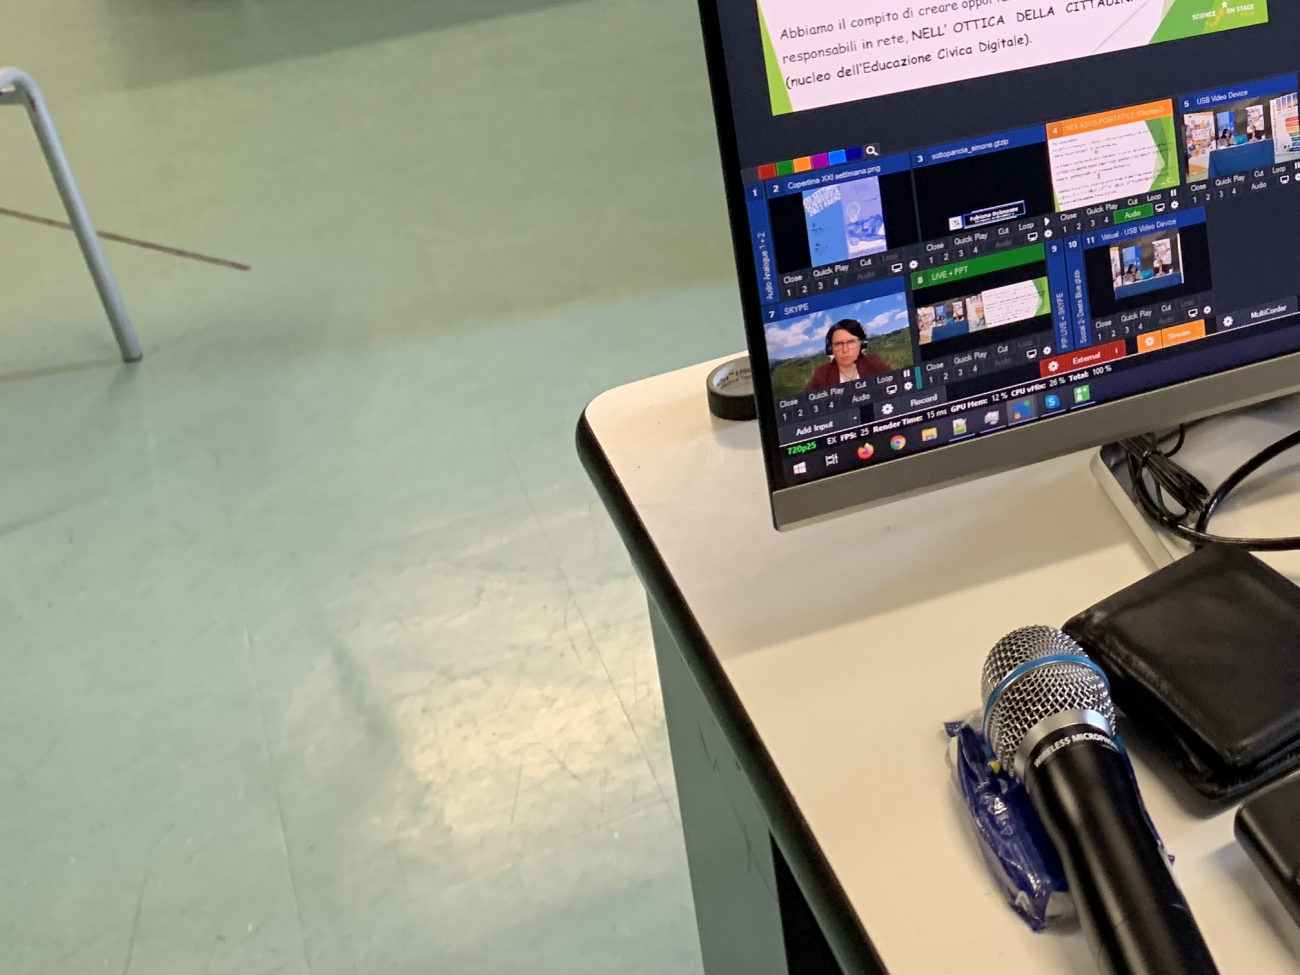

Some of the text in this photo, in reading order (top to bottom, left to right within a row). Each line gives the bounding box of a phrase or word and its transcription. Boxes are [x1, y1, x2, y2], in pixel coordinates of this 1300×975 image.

[780, 24, 834, 40] Abbiamo
[838, 18, 846, 30] il
[851, 11, 899, 31] compito
[902, 7, 914, 19] di
[918, 0, 958, 16] creare
[1192, 11, 1216, 21] SCIENCE
[1236, 4, 1254, 13] STAGE
[782, 41, 857, 64] responsabili
[862, 39, 873, 49] in
[877, 33, 908, 48] rete,
[911, 23, 948, 42] NELL'
[953, 15, 1005, 33] OTTICA
[1017, 6, 1055, 23] DELLA
[785, 33, 1032, 90] (nucleo dell'Educazione Civica Digitale).
[1196, 88, 1248, 105] USB Video Device
[788, 177, 820, 190] Copertina
[783, 303, 810, 315] SKYPE
[1250, 304, 1287, 319] MultiCorder
[1072, 352, 1101, 365] External
[910, 395, 938, 407] Record
[787, 442, 817, 455] 720p25
[860, 428, 870, 437] 25
[873, 421, 901, 433] Render
[902, 415, 923, 427] Time:
[796, 421, 834, 436] Add Input
[1034, 737, 1071, 768] WIRELESS
